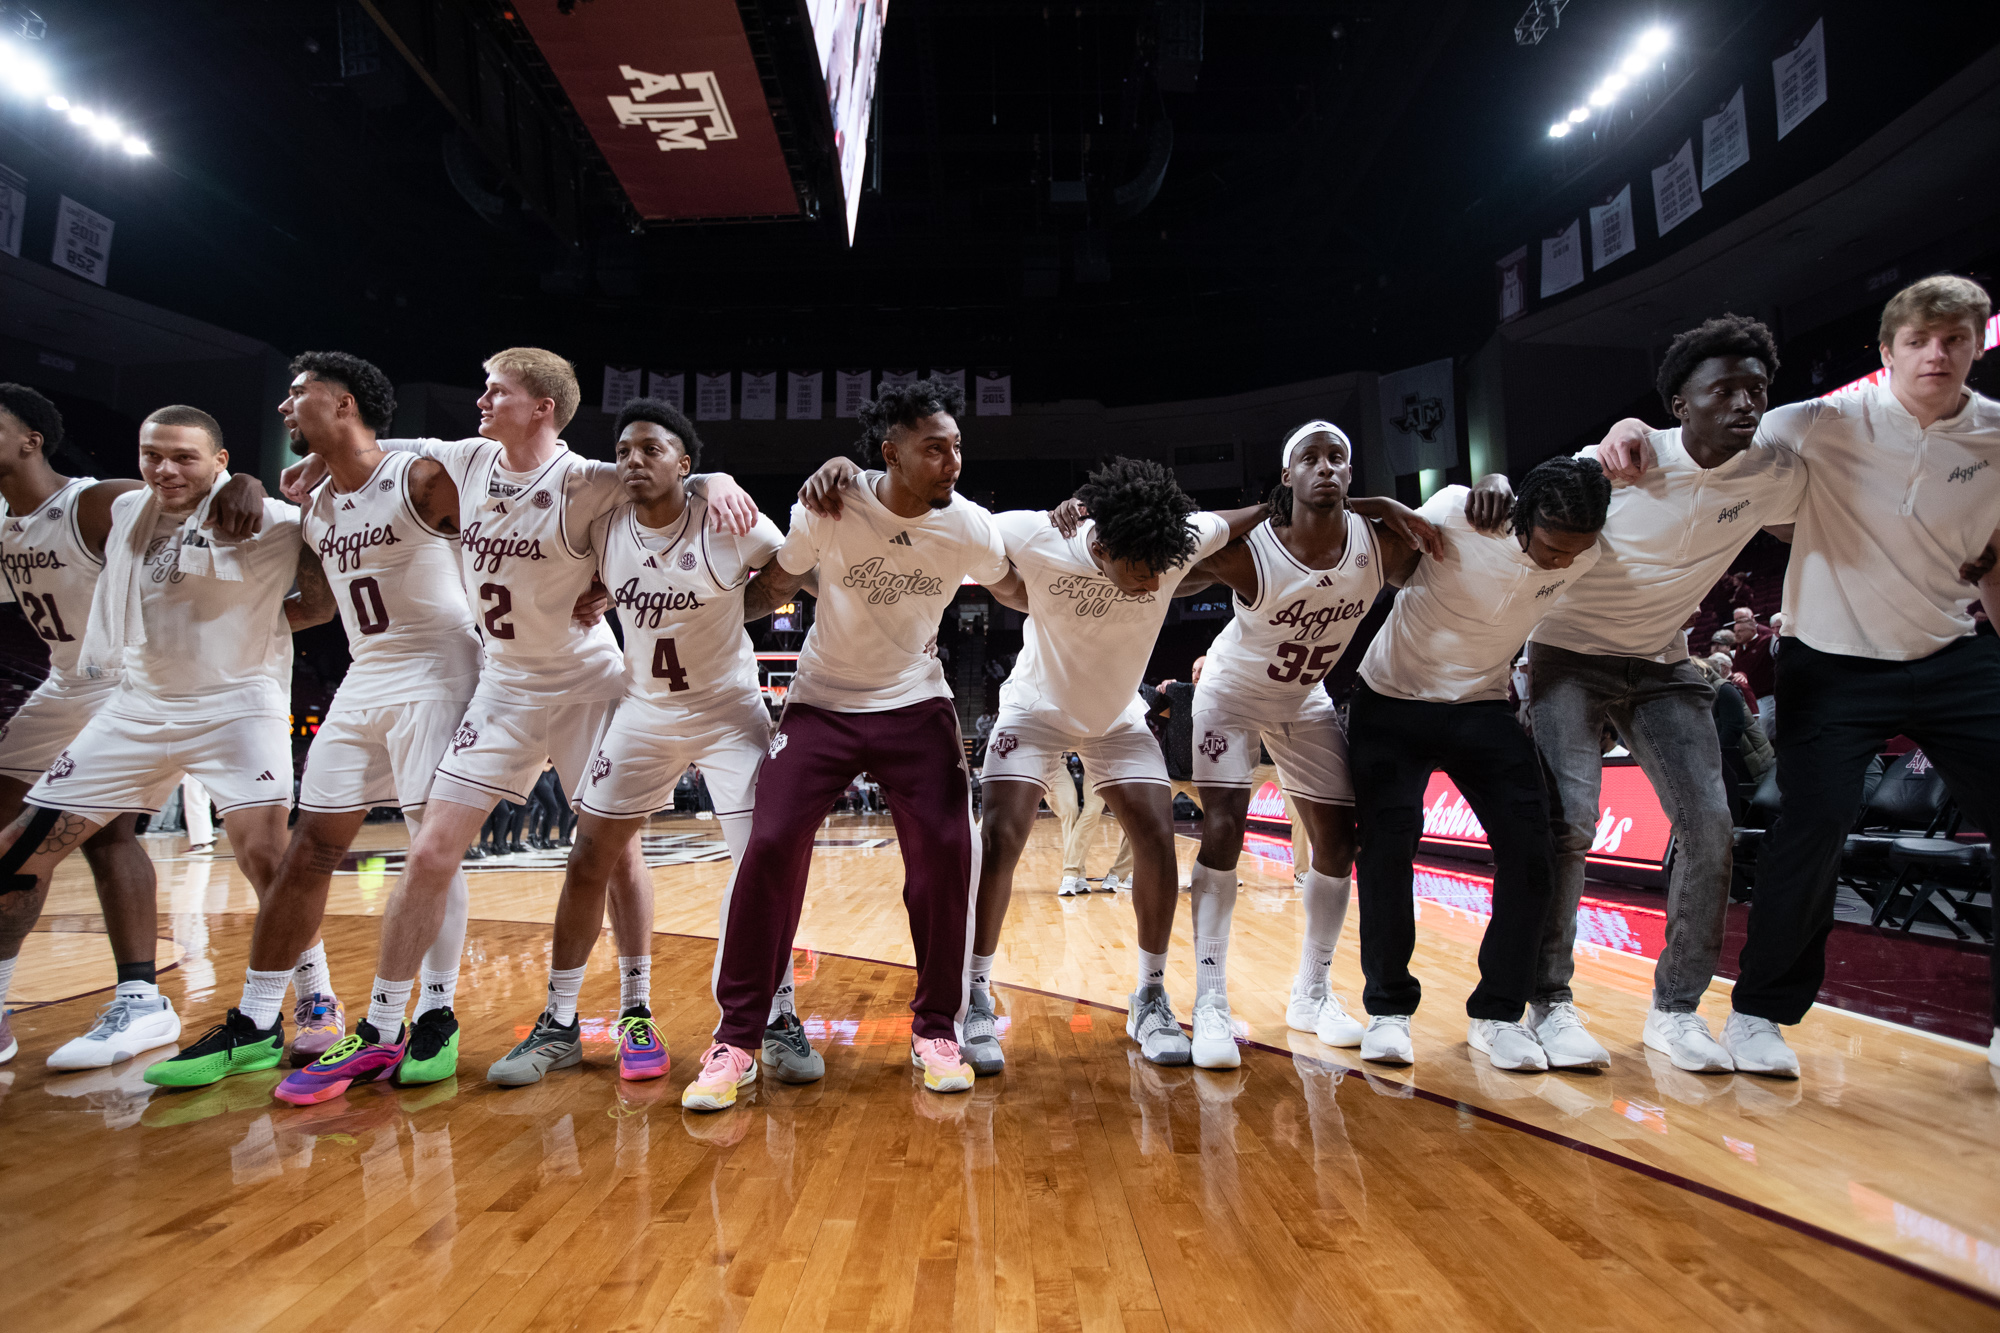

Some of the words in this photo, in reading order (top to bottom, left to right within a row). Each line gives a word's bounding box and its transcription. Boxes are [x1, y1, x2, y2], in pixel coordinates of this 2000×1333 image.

[70, 221, 99, 247] 2011
[67, 250, 95, 274] 852
[982, 394, 1005, 403] 2015
[1947, 459, 1989, 483] Aggies
[1717, 499, 1751, 523] Aggies
[0, 542, 67, 584] ggies
[319, 522, 401, 573] Aggies
[461, 522, 548, 574] Aggies
[843, 557, 942, 604] Aggies
[1535, 579, 1566, 600] Aggies
[22, 591, 76, 642] 21
[349, 576, 389, 635] 0
[480, 582, 515, 640] 2
[615, 577, 706, 629] Aggies
[1268, 598, 1365, 640] Aggies
[652, 638, 689, 692] 4
[1267, 641, 1341, 685] 35
